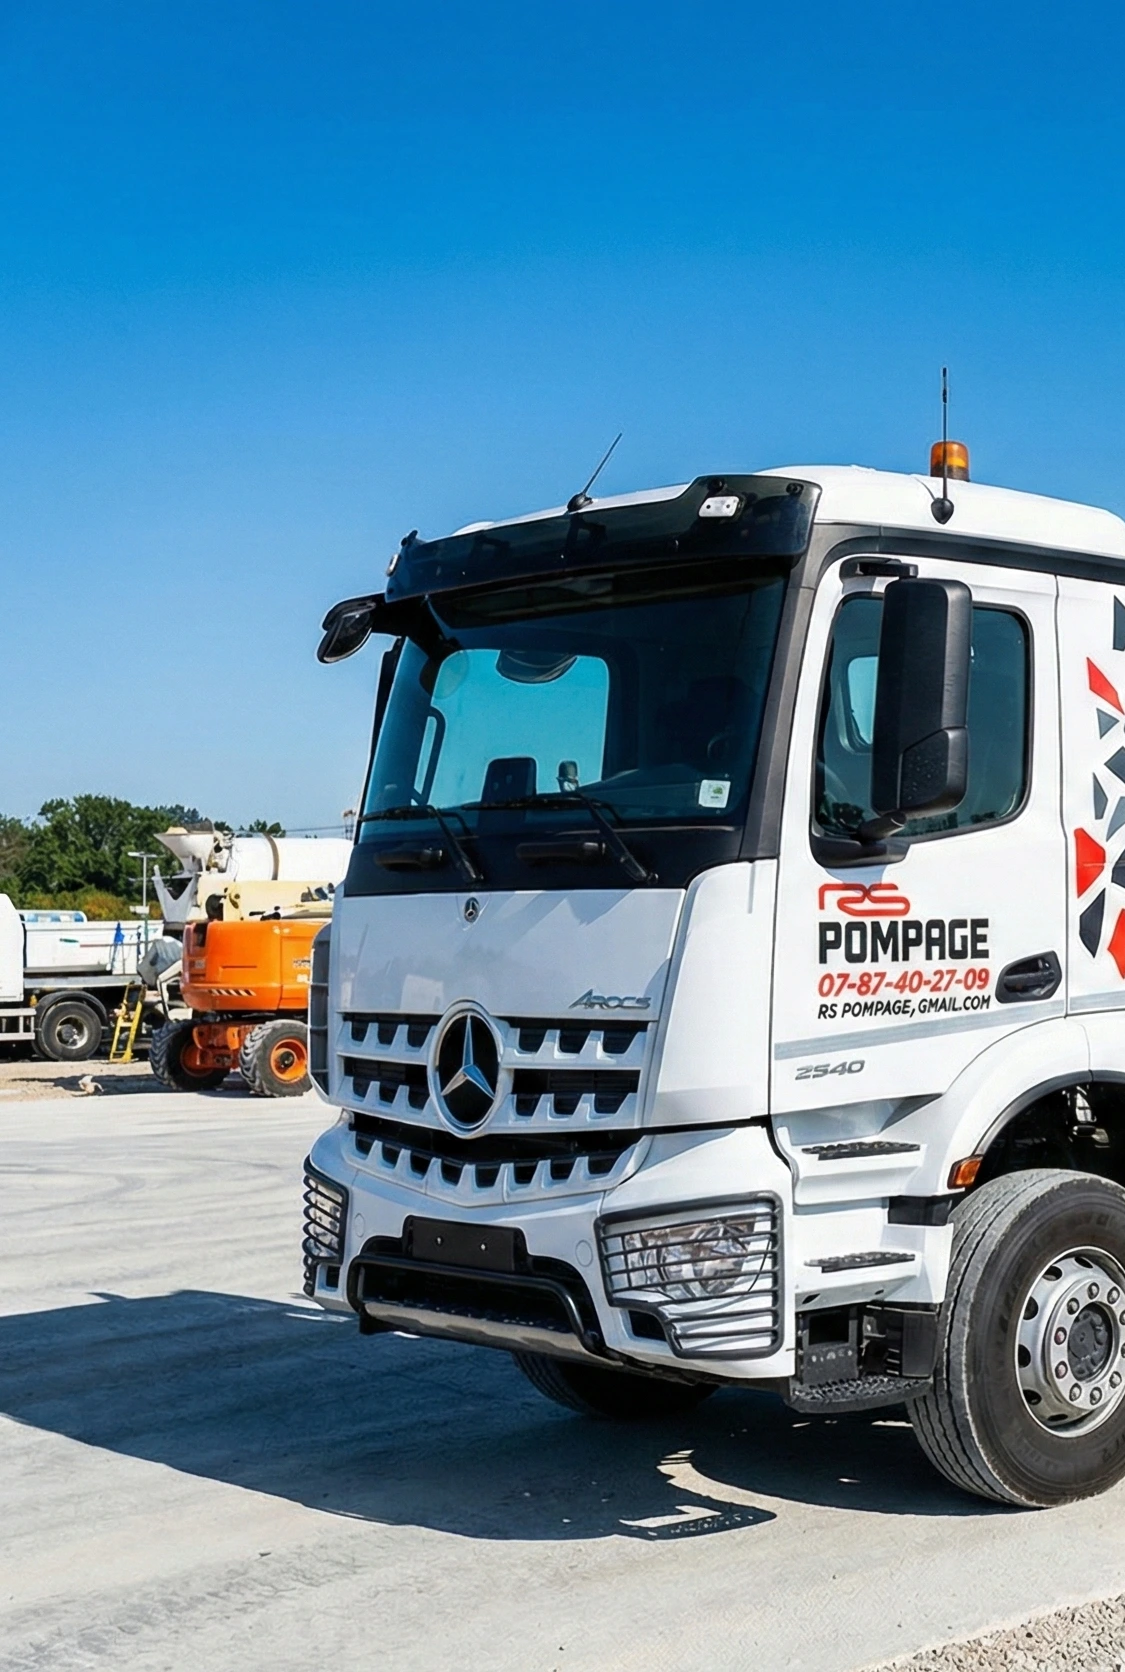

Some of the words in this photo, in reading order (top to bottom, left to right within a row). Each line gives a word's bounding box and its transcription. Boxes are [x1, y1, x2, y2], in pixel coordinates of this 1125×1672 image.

[818, 883, 911, 917] RS
[818, 918, 990, 964] POMPAGE
[818, 968, 991, 998] 07-87-40-27-09
[817, 1003, 838, 1019] RS
[794, 1060, 866, 1081] 2540
